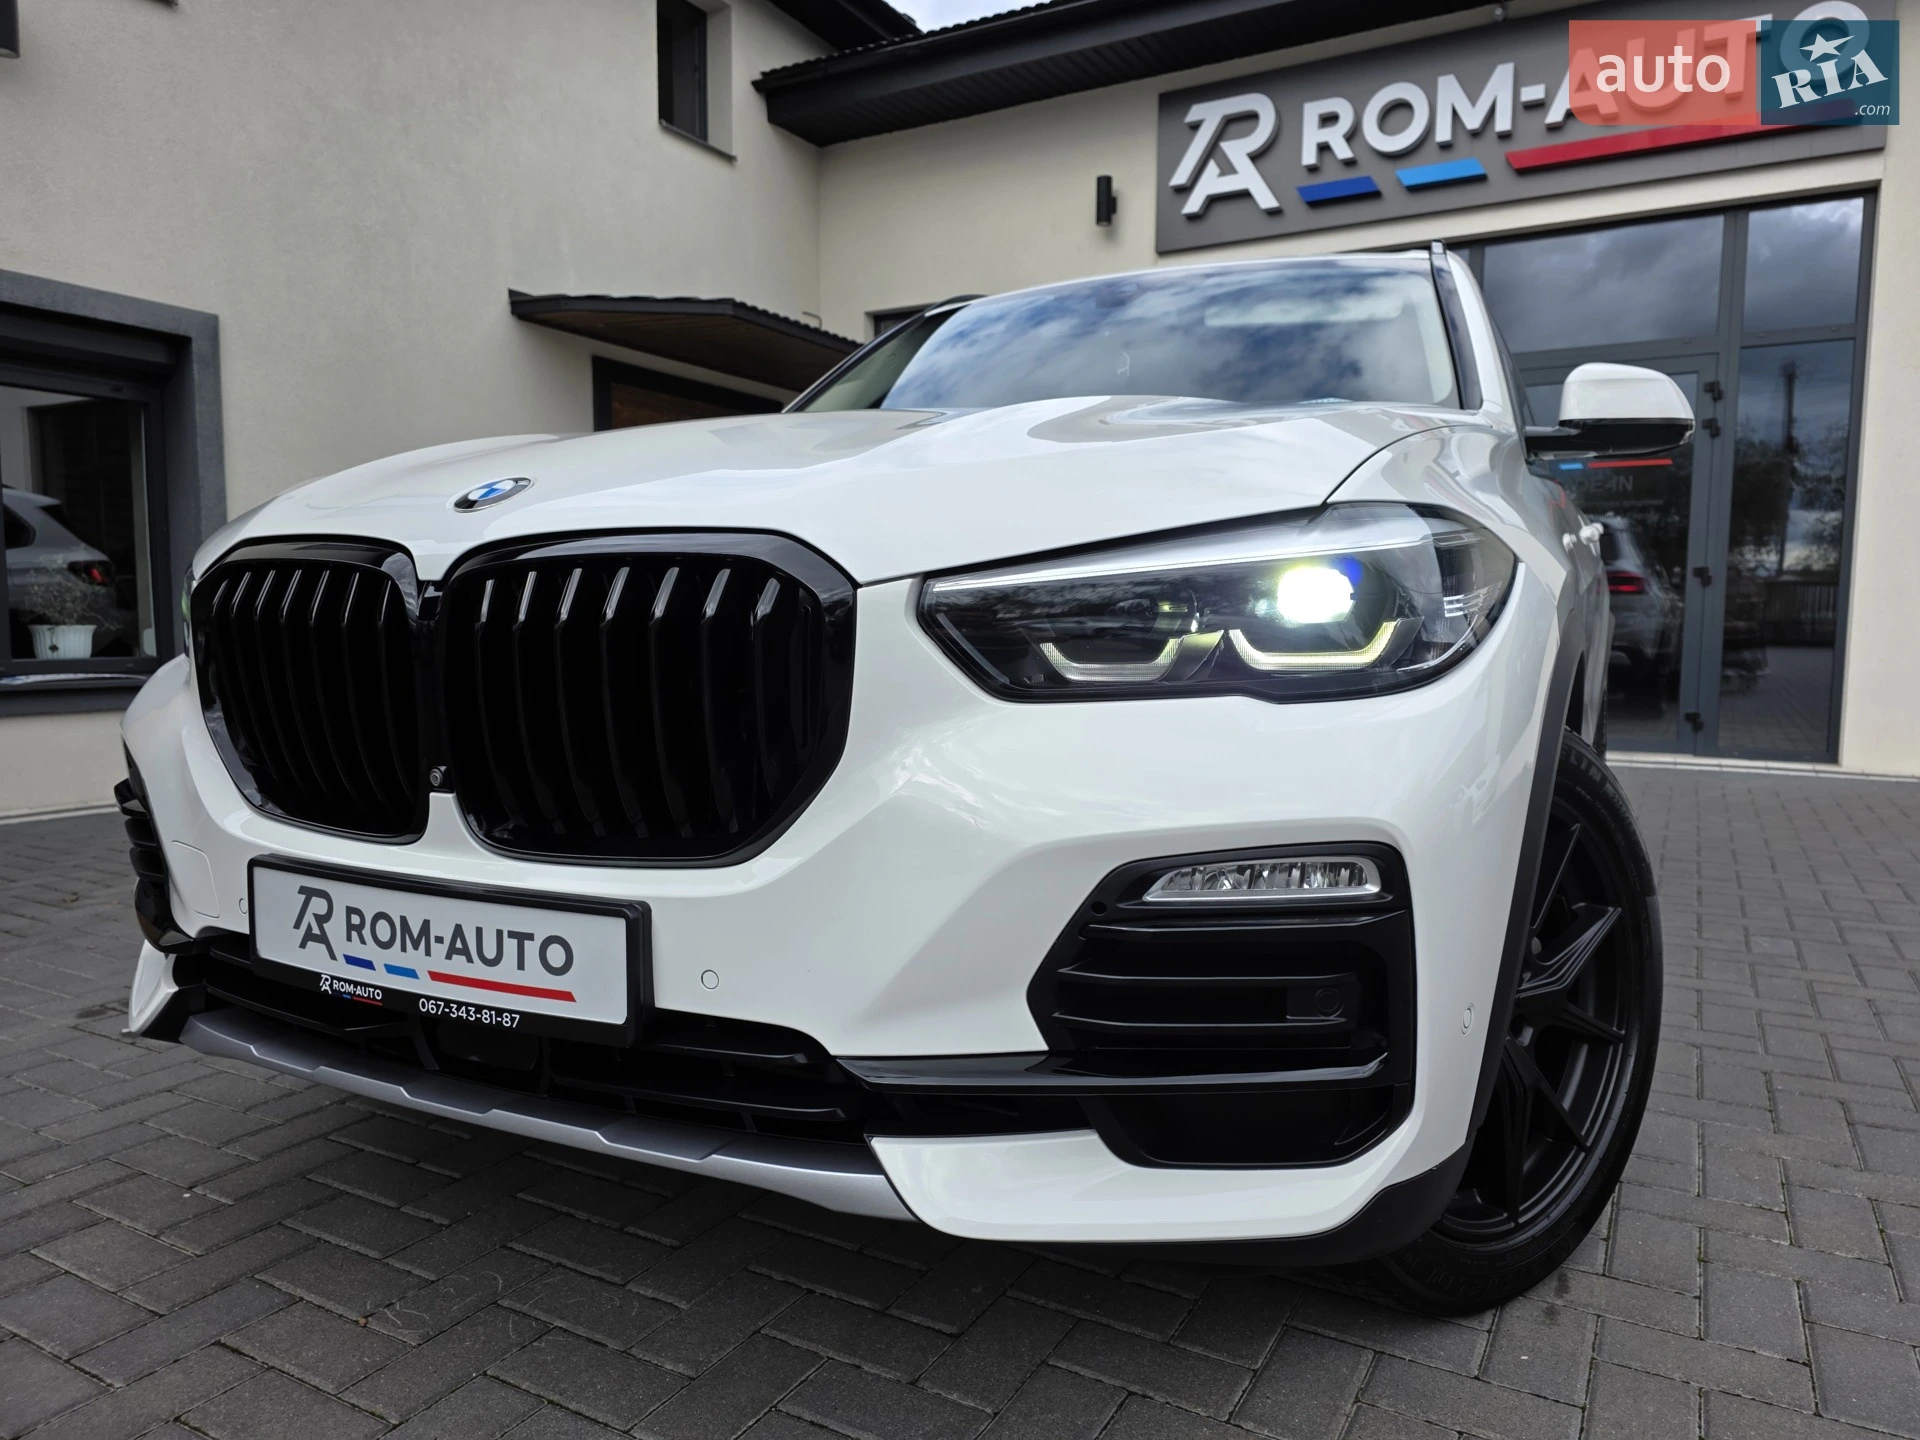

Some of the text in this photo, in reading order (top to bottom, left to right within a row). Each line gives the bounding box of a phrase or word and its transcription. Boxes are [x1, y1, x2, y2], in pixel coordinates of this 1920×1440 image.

[345, 905, 574, 977] ROM-AUTO
[333, 980, 382, 1000] ROM-AUTO
[419, 998, 520, 1028] 067-343-81-87
